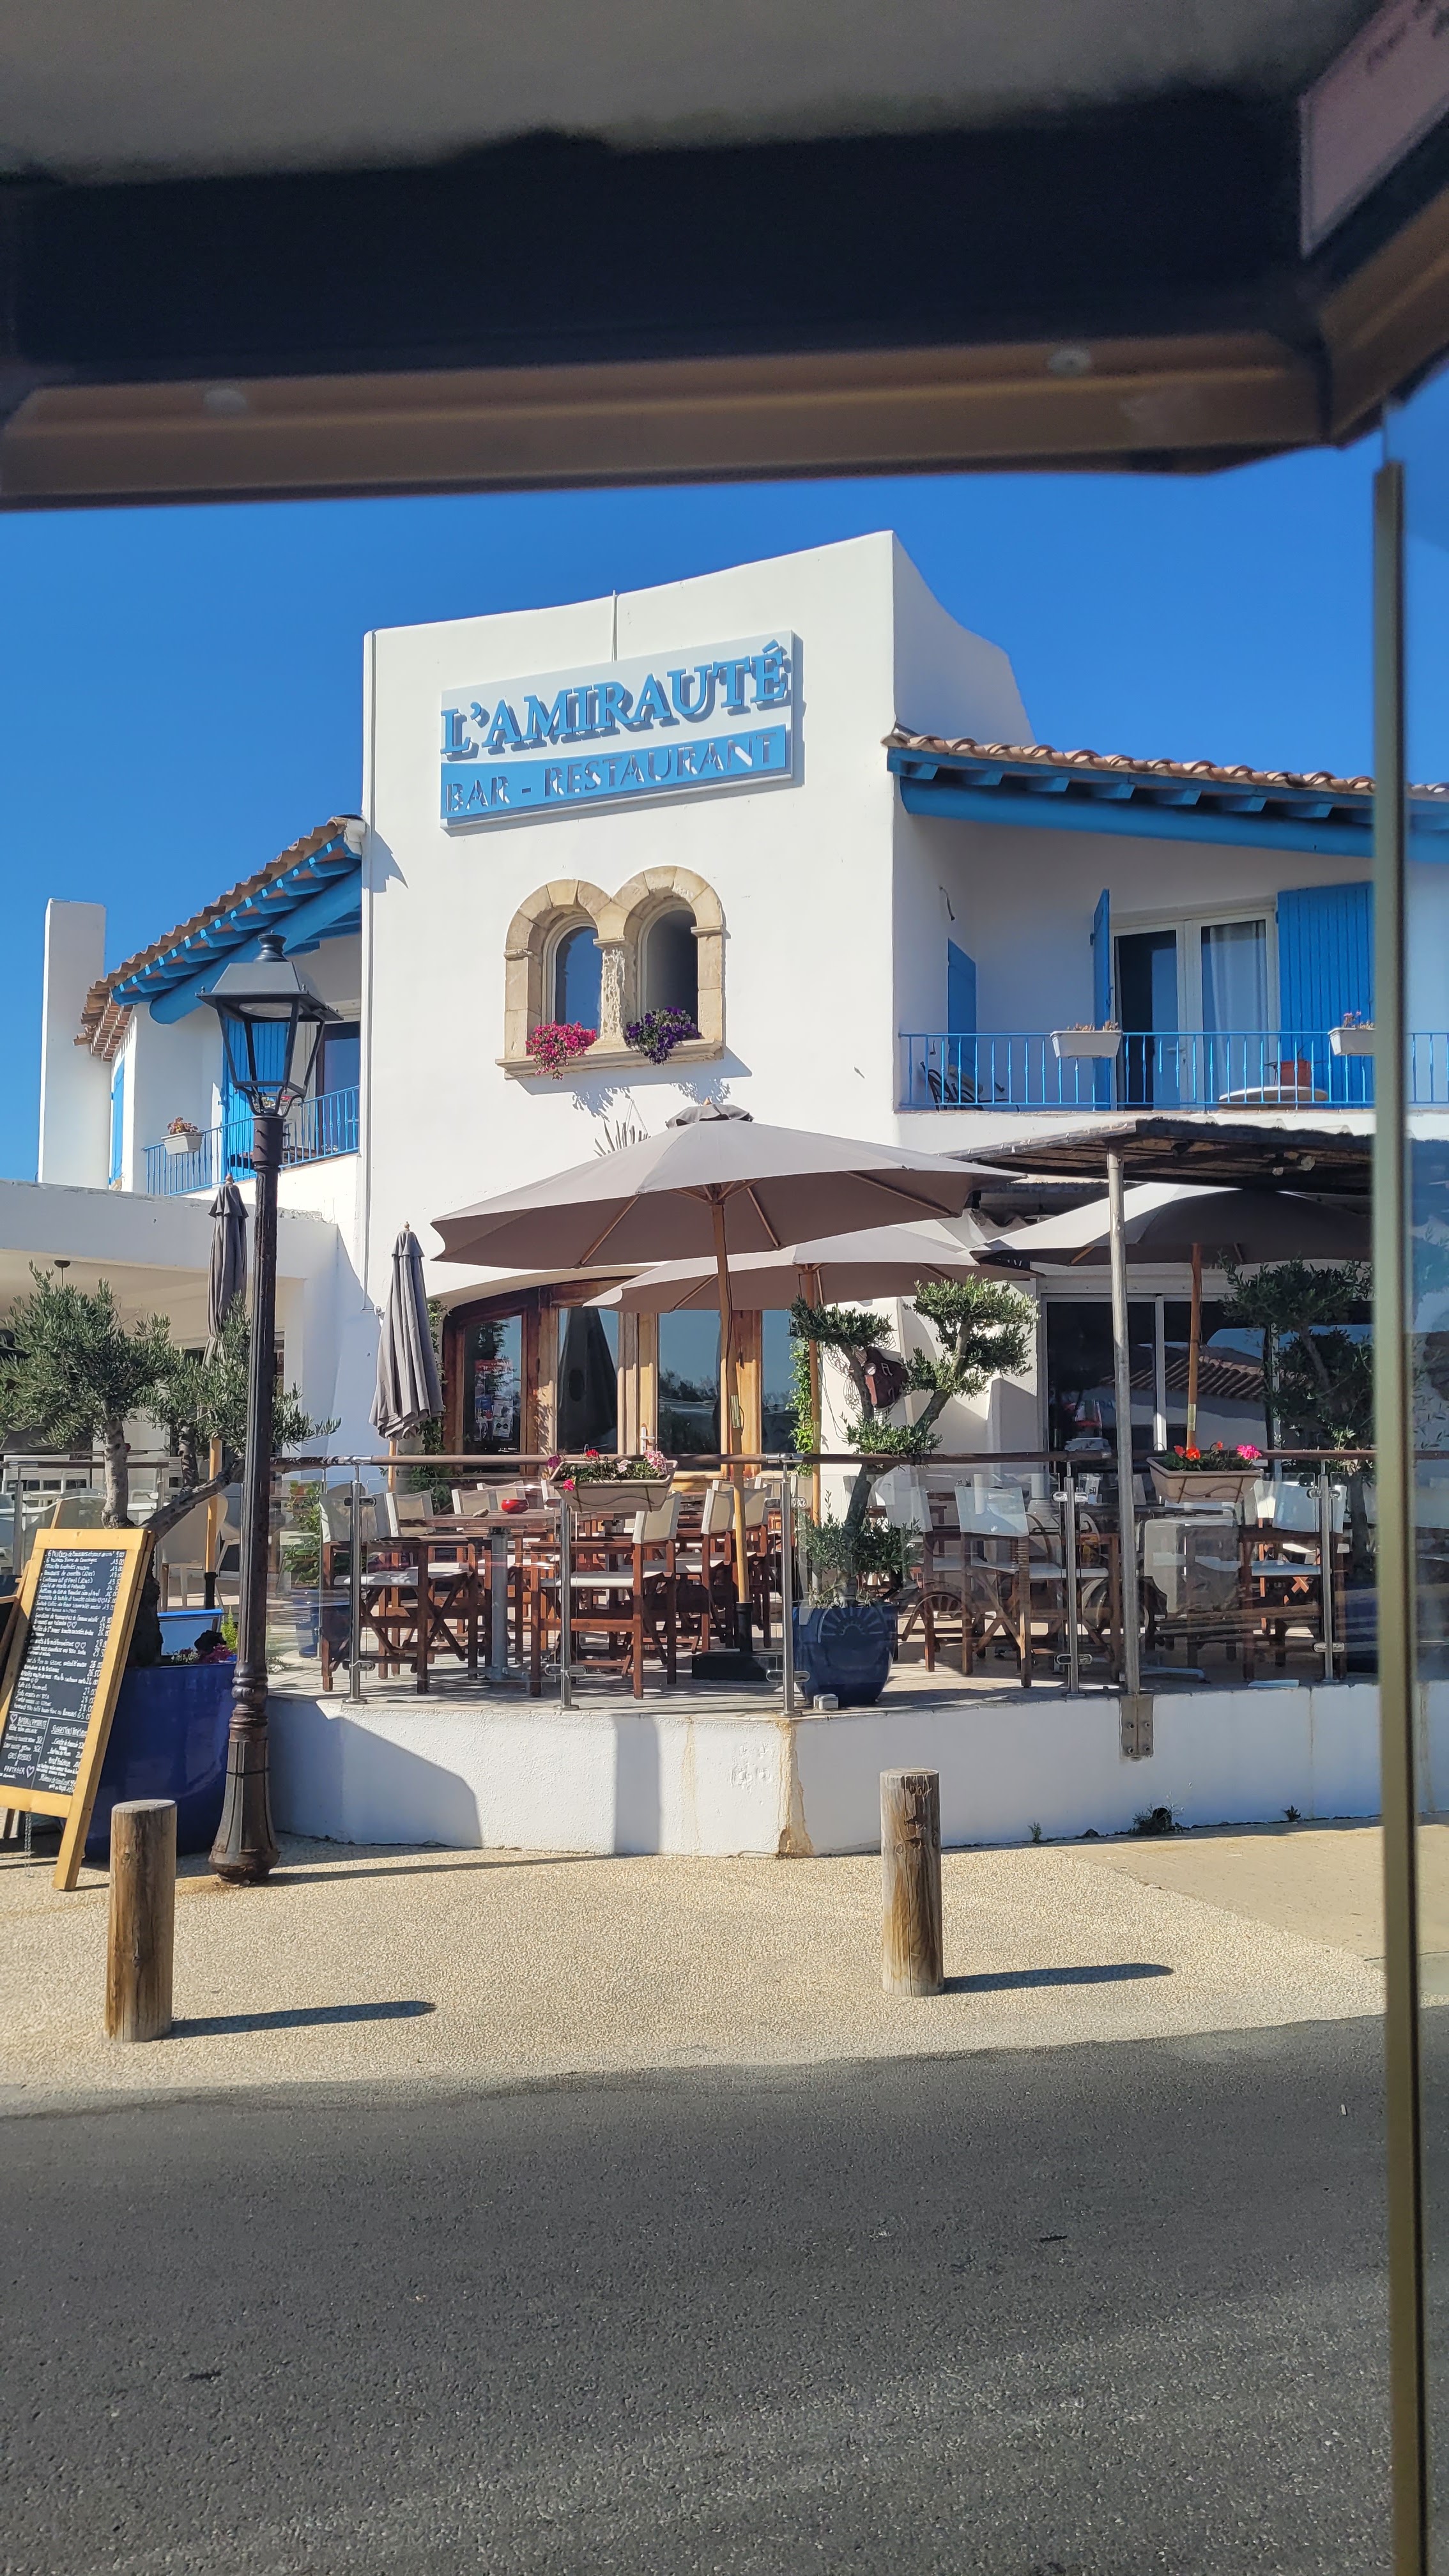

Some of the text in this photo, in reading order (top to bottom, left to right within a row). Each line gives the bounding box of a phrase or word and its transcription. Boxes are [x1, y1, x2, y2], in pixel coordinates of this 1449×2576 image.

[440, 640, 788, 755] L'AMIRAUTÉ
[445, 774, 510, 812] BAR
[544, 732, 778, 797] RESTAURANT
